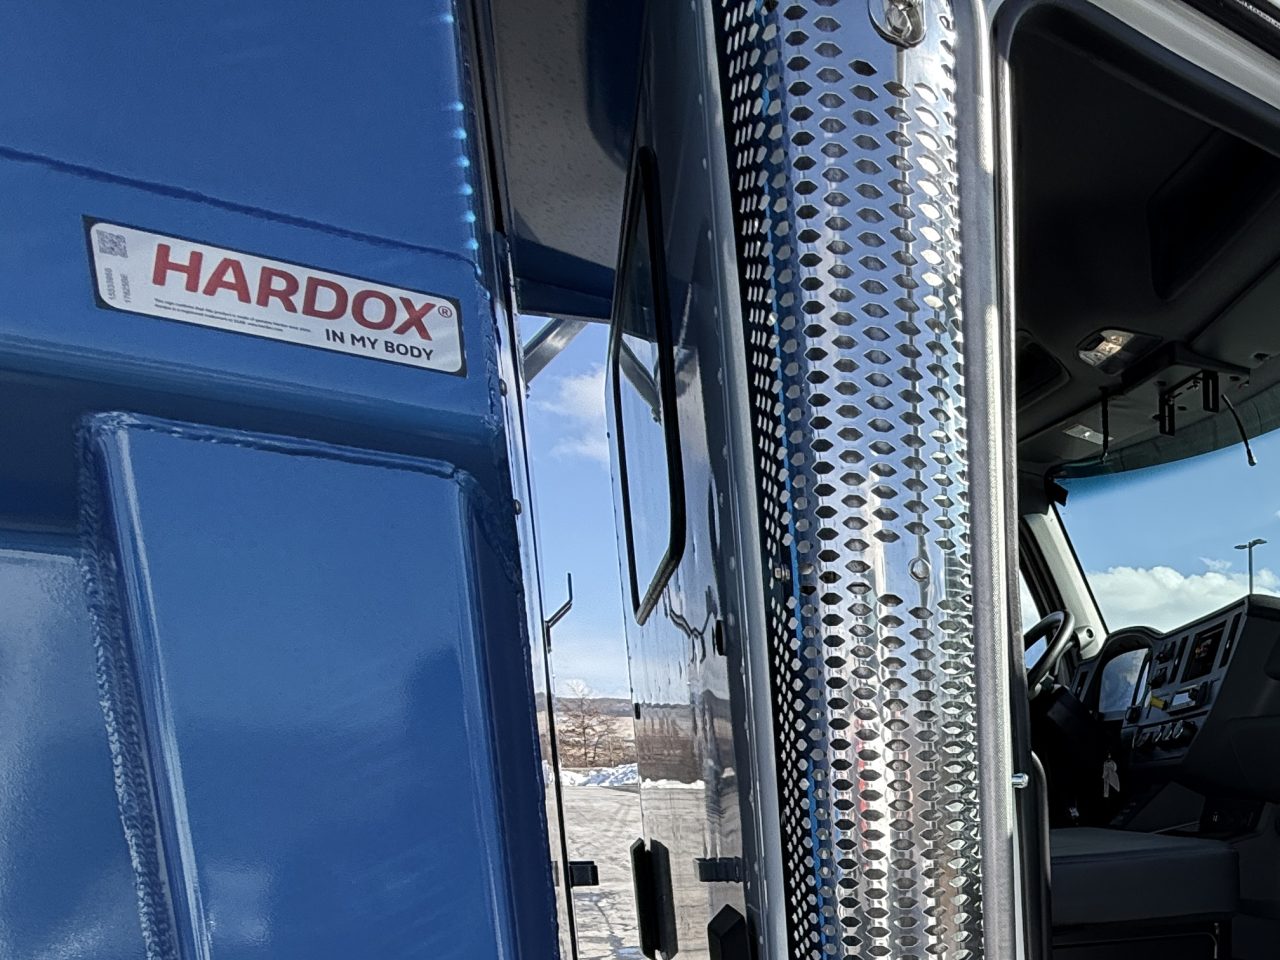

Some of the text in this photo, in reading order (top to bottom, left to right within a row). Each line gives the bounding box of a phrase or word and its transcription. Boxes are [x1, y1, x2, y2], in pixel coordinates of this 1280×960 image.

[326, 328, 434, 361] IN MY BODY
